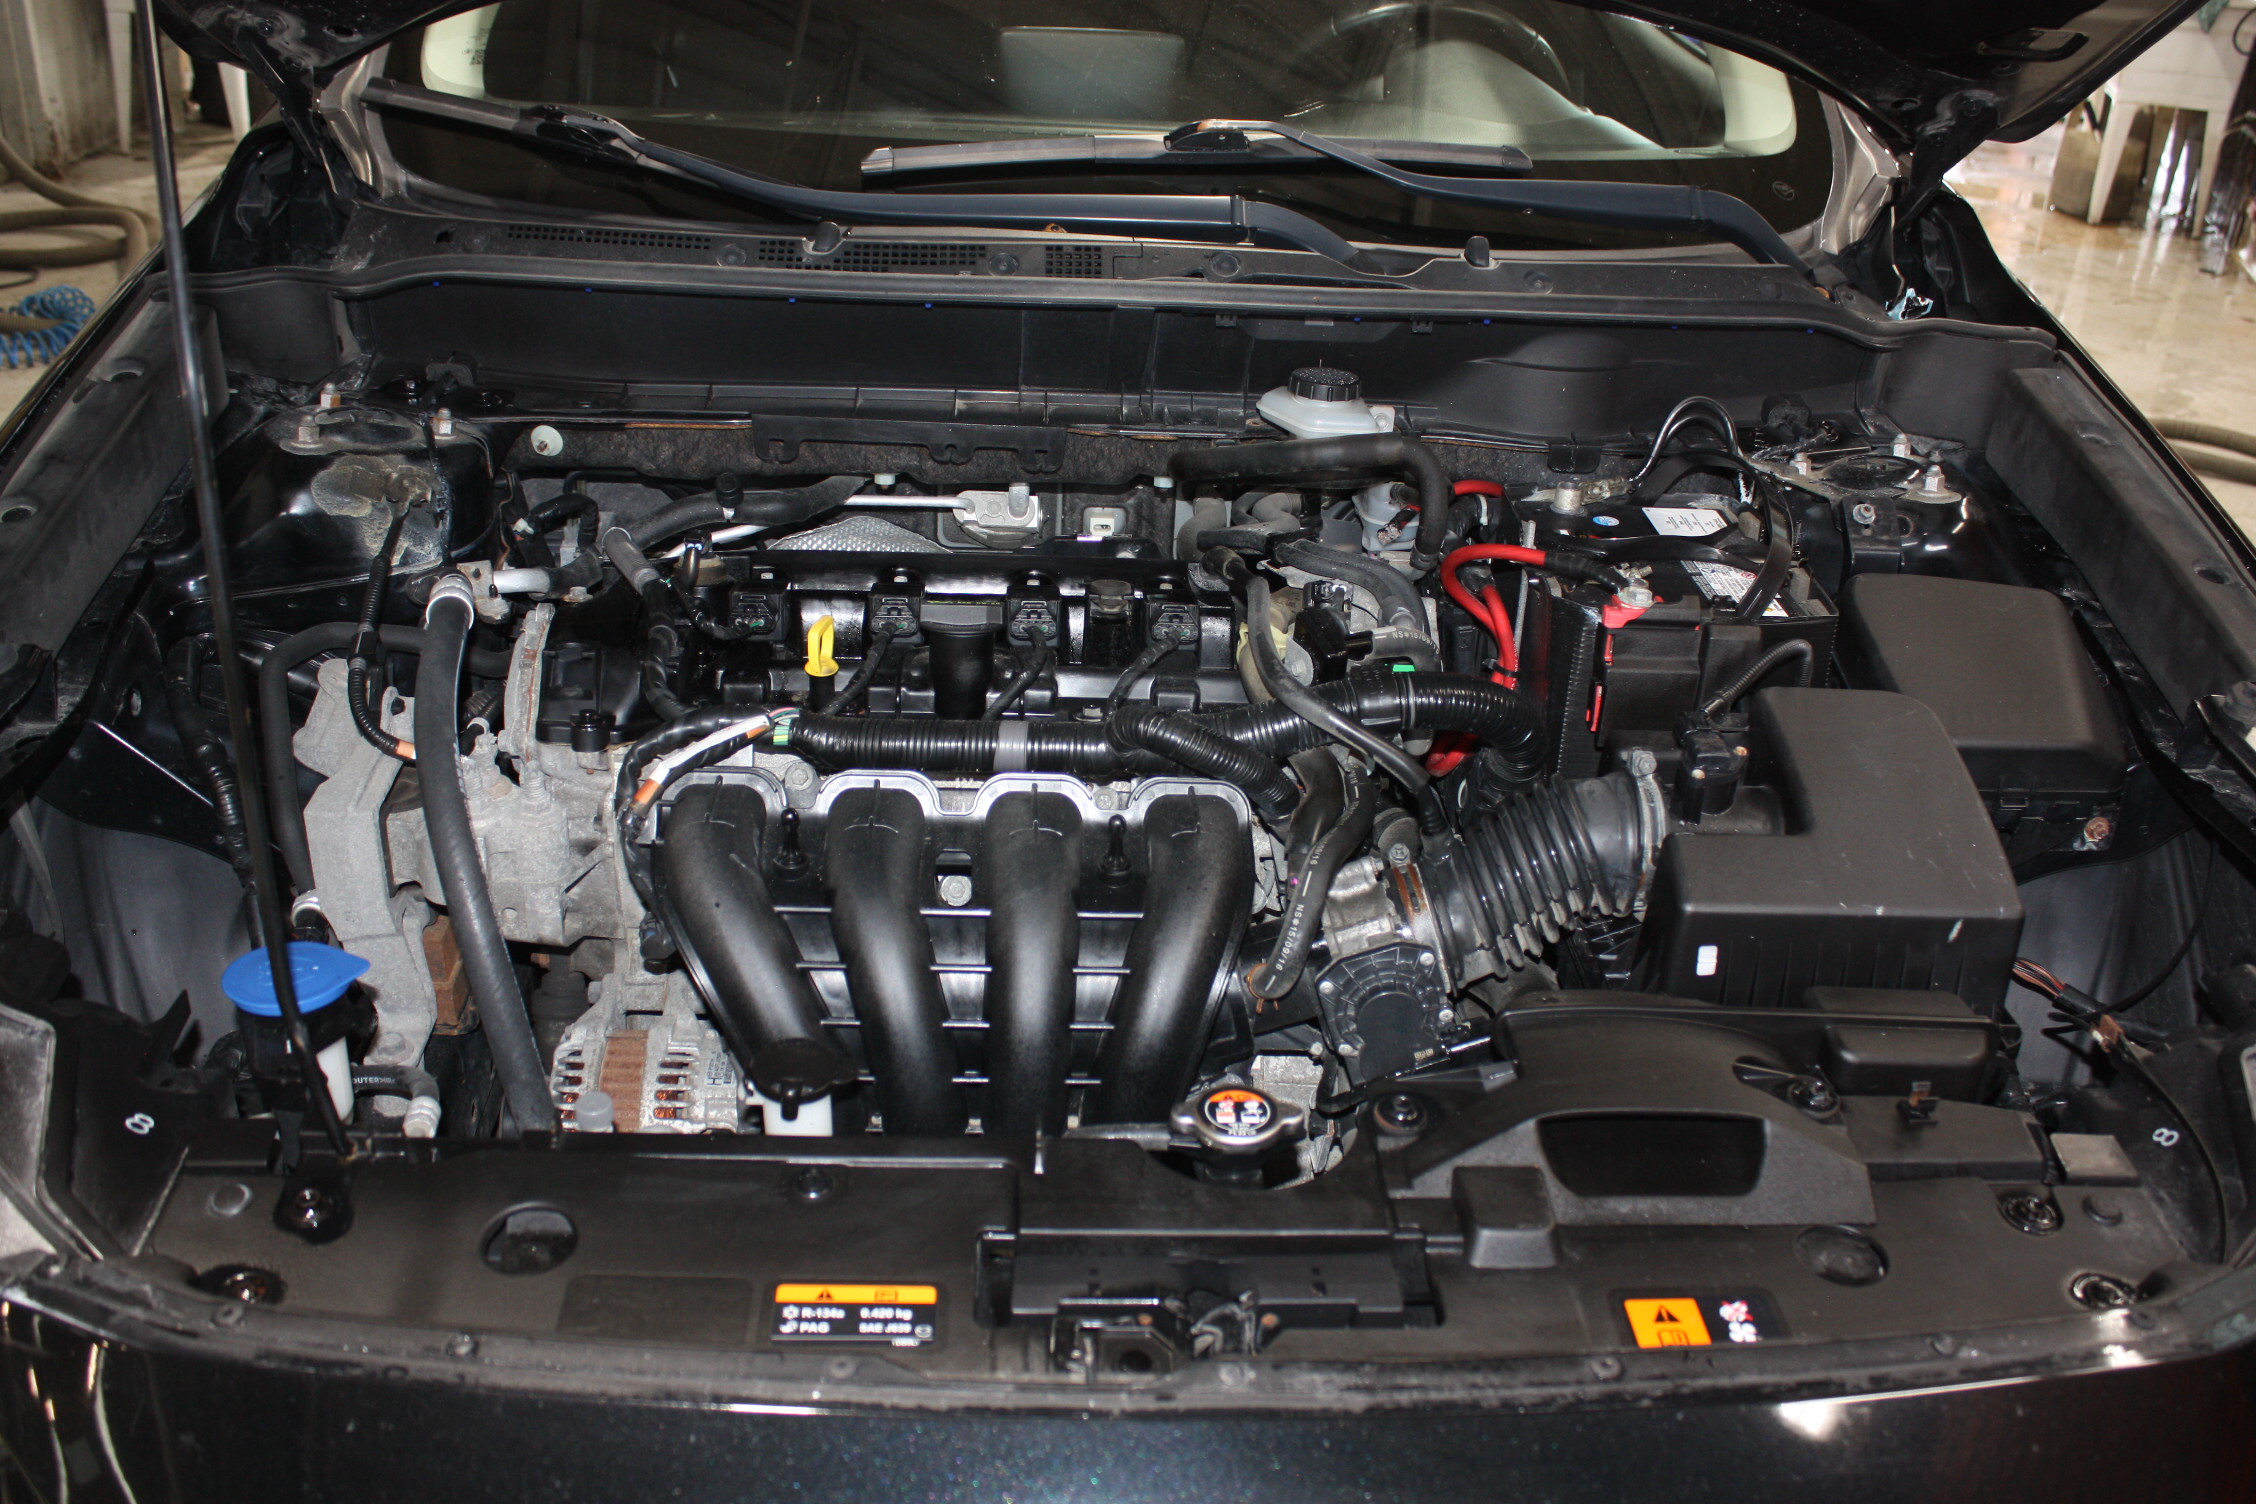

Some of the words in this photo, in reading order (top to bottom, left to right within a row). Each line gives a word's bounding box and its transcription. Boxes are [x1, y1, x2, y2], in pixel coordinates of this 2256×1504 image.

[801, 1307, 846, 1320] R-134a
[895, 1307, 913, 1321] kg
[799, 1321, 830, 1334] PAG
[858, 1321, 884, 1334] SAE
